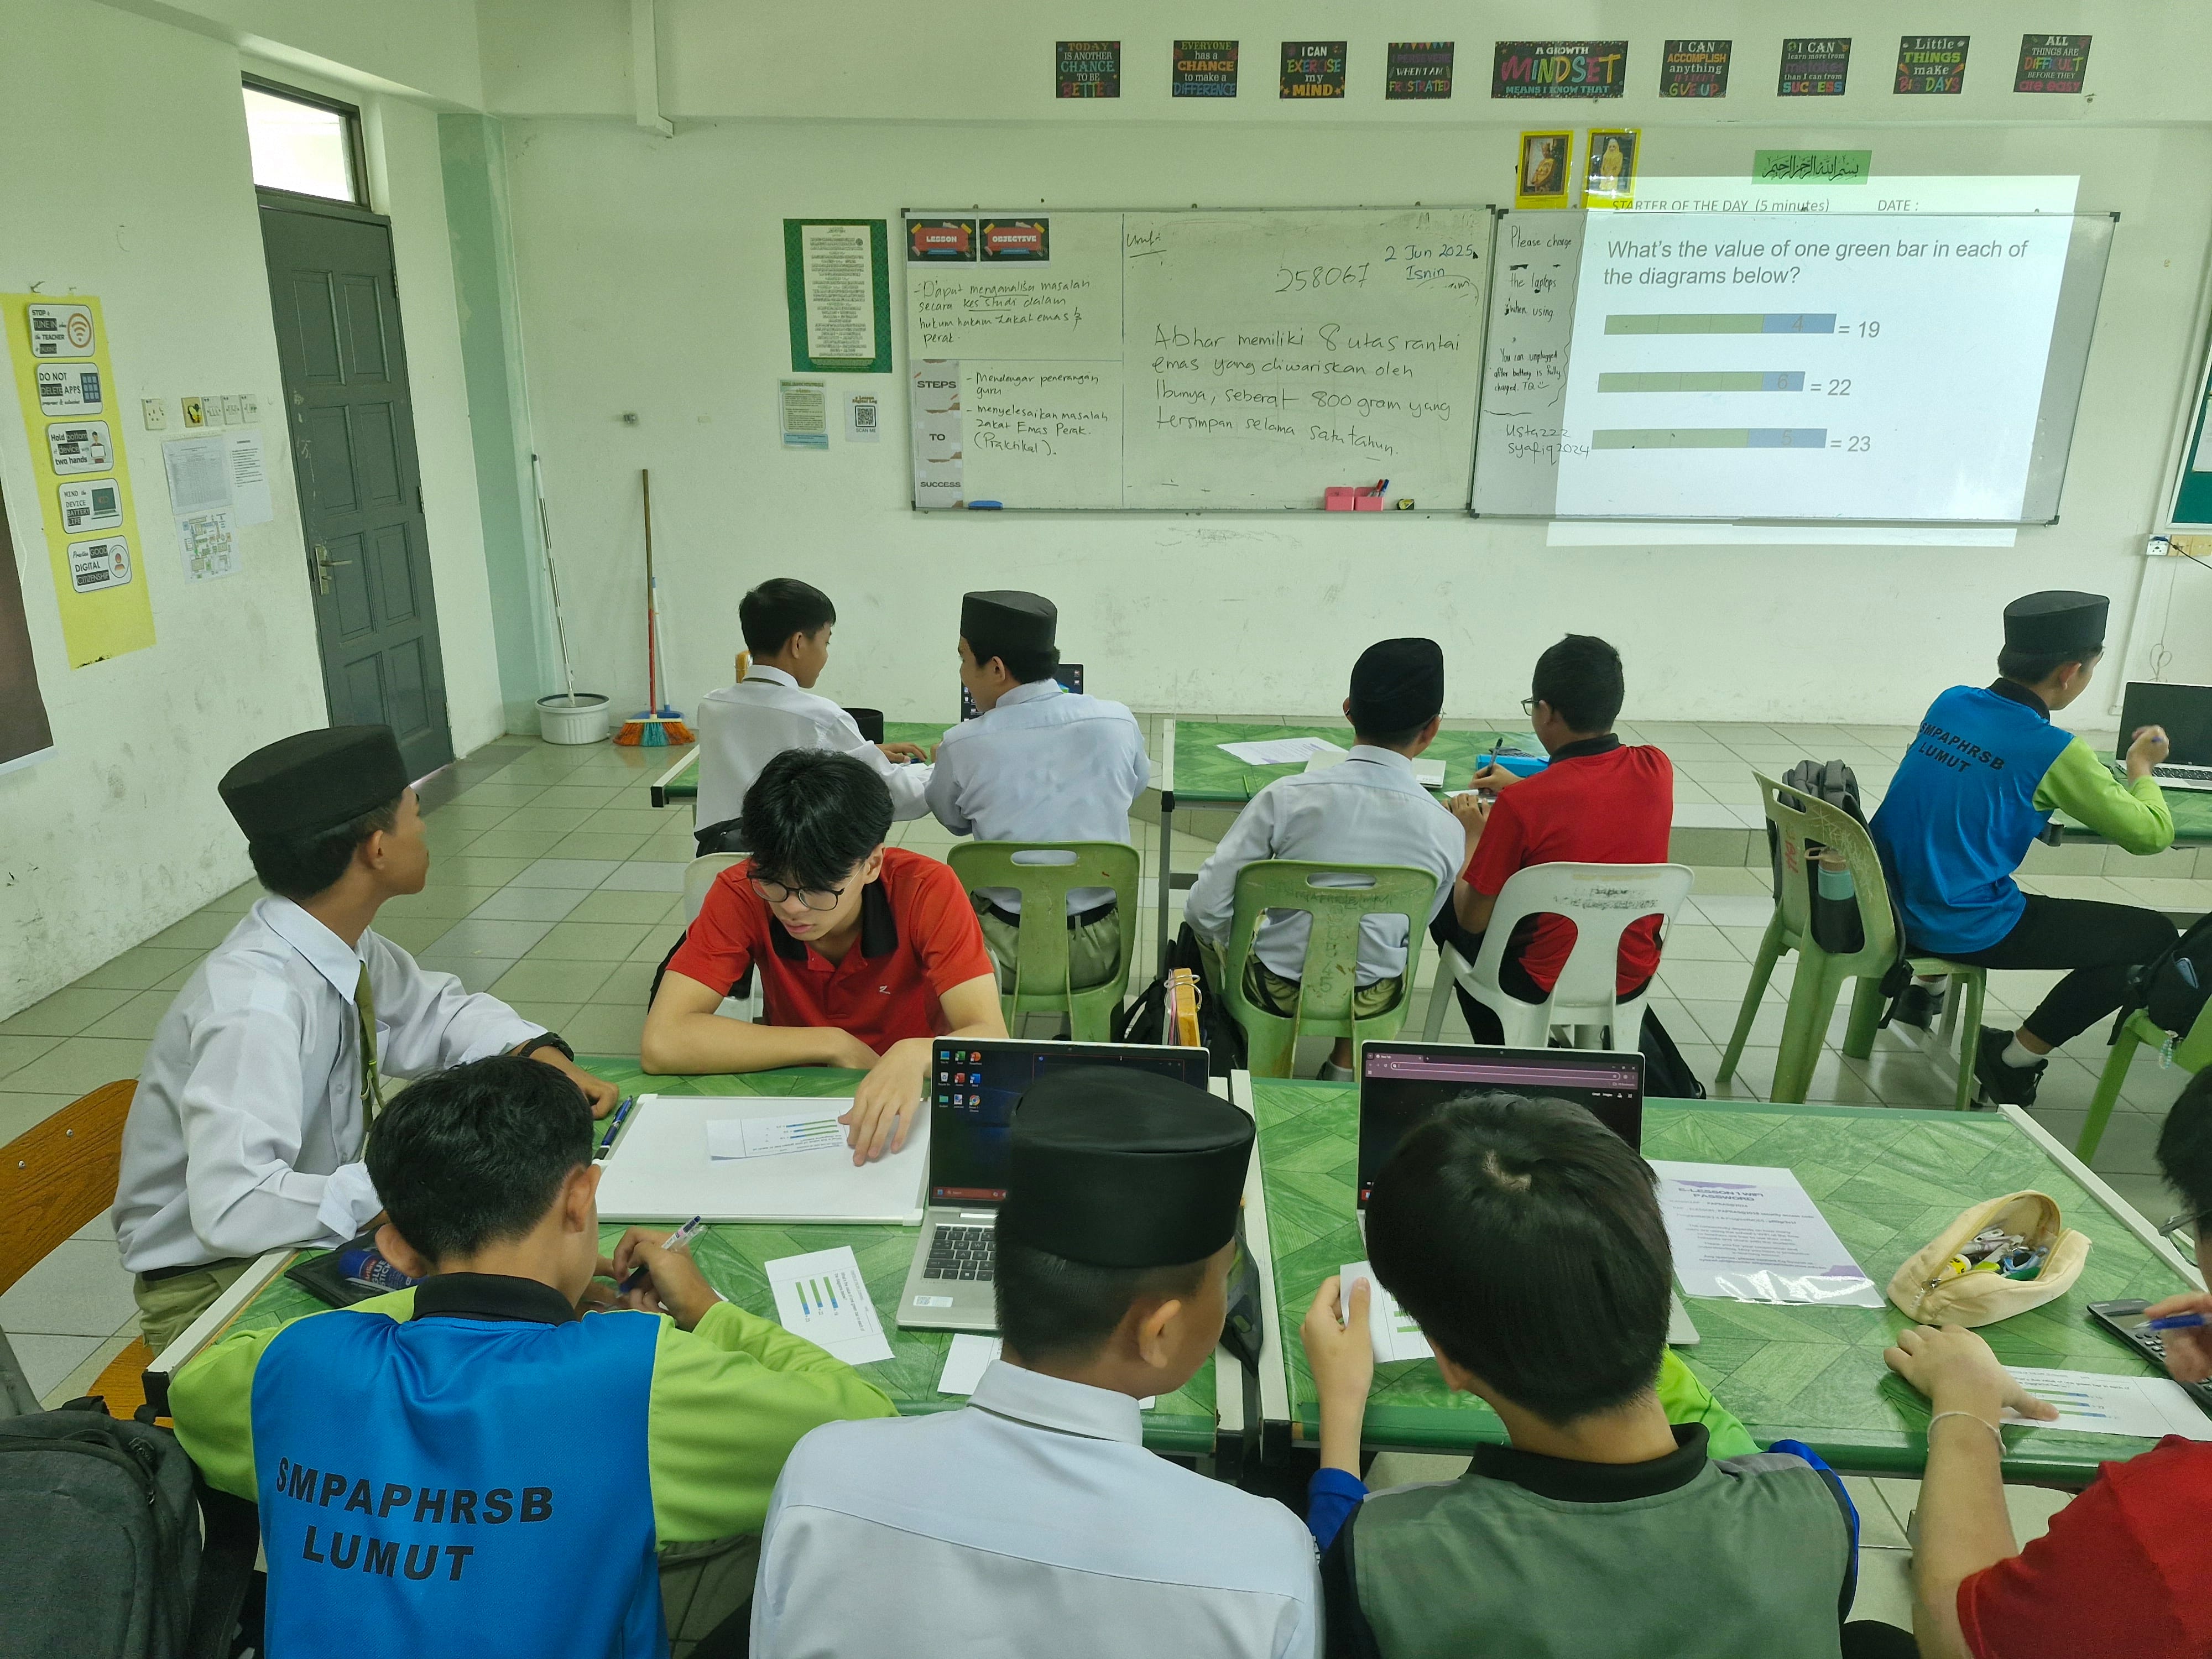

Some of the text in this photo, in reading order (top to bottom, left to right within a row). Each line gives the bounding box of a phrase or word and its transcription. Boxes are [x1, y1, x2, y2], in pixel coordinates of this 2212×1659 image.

[1068, 43, 1109, 51] TODAY
[1182, 41, 1232, 50] EVERYONE
[1688, 41, 1715, 53] CAN
[1808, 42, 1835, 53] CAN
[1914, 38, 1954, 49] Little
[2045, 35, 2069, 46] ALL
[1074, 51, 1112, 60] ANOTHER
[1195, 51, 1209, 59] has
[1307, 46, 1327, 56] CAN
[1667, 53, 1726, 63] ACCOMPLISH
[1903, 51, 1961, 63] THINGS
[2032, 48, 2062, 56] THINGS
[1061, 61, 1115, 72] CHANCE
[1178, 61, 1234, 71] CHANCE
[1501, 54, 1621, 84] MINDSET
[1670, 63, 1722, 74] anything
[2024, 56, 2084, 71] DIFFIULT
[1396, 67, 1421, 76] WHEN
[1305, 74, 1323, 84] my
[1899, 76, 1960, 93] BIG DAYS
[2019, 80, 2080, 92] are easy
[1173, 82, 1235, 96] DIFFERENCE
[1292, 84, 1333, 96] MIND
[1506, 86, 1541, 94] MEANS
[1580, 85, 1610, 93] THAT
[1669, 82, 1719, 97] GVE UP
[1782, 81, 1843, 93] SUCCESS
[1671, 201, 1690, 211] OF
[1693, 201, 1718, 211] THE
[1721, 200, 1748, 212] DAY
[1755, 199, 1769, 213] (5
[1772, 199, 1830, 213] minutes)
[1877, 200, 1912, 212] DATE
[1511, 225, 1572, 249] Please charge
[1405, 244, 1432, 260] Jun
[1608, 239, 2030, 262] What's the value of one green bar in each of
[1275, 262, 1370, 293] 258067
[1406, 265, 1445, 280] Isnin
[1604, 267, 1801, 289] the diagrams below?
[1041, 280, 1089, 291] masalah
[1510, 272, 1557, 294] the laptops
[919, 296, 1066, 312] secara dalam
[1792, 317, 1804, 332] 4
[1859, 321, 1880, 338] 19
[1155, 325, 1460, 351] Abhar memiliki utas rantai
[1530, 350, 1557, 363] unplugged
[1151, 357, 1413, 378] emas yang diwariskan oleh
[1494, 365, 1561, 380] after battery fully
[39, 372, 67, 380] DO NOT
[977, 372, 1099, 390] Mendengar penerangan
[1777, 374, 1788, 390] 6
[41, 385, 81, 395] DELETE APPS
[977, 386, 1002, 400] guru
[1828, 379, 1851, 397] 22
[1225, 388, 1300, 409] seberat
[1312, 390, 1352, 408] 800
[1357, 398, 1401, 419] gram
[1408, 400, 1451, 421] yang
[977, 404, 1108, 421] menyelesaikan masalah
[1018, 422, 1048, 434] Emas
[1157, 406, 1233, 430] tersimpan
[1246, 414, 1295, 436] selama
[59, 445, 80, 453] device
[1848, 435, 1871, 452] 23
[69, 456, 88, 464] hands
[66, 508, 90, 517] BATTERY
[90, 547, 108, 556] GOOD
[75, 561, 101, 572] DIGITAL
[77, 571, 109, 585] CITIZENSHIP
[1919, 722, 2005, 770] SMPAPHRSB
[1918, 742, 1971, 773] LUMUT
[372, 1260, 386, 1283] GLUE
[276, 1457, 554, 1525] SMPAPHRSB
[303, 1525, 474, 1581] LUMUT
